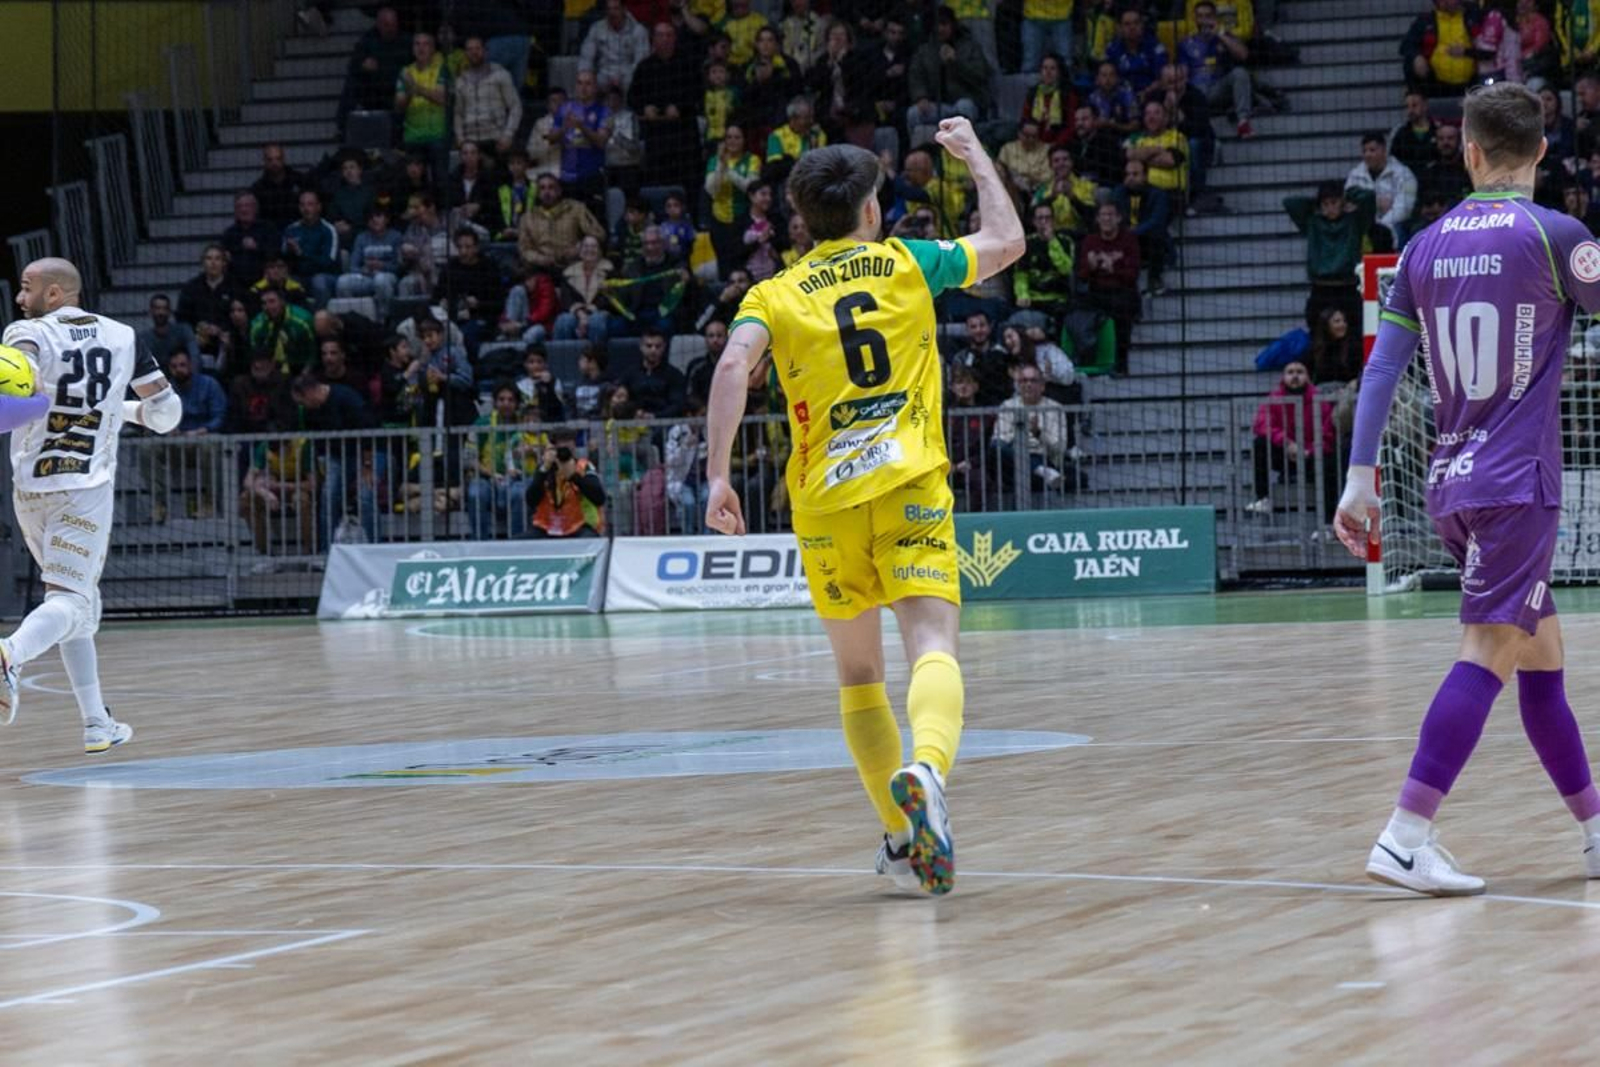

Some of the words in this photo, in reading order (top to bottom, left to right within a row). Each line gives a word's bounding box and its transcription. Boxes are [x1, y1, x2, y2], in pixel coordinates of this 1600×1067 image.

[799, 266, 837, 294] DANI
[839, 256, 896, 282] ZURDO
[1433, 254, 1503, 279] RIVILLOS
[834, 291, 892, 388] 6
[1435, 301, 1500, 400] 10
[1509, 304, 1536, 400] BAUHAUS
[55, 346, 112, 408] 28
[1027, 532, 1092, 554] CAJA
[1098, 528, 1189, 551] RURAL
[656, 549, 806, 581] OEDI
[1073, 554, 1141, 580] JAÉN
[405, 570, 432, 597] El
[427, 564, 579, 605] Alcázar
[667, 582, 741, 596] especialistas
[745, 583, 760, 592] en
[763, 583, 790, 594] gran
